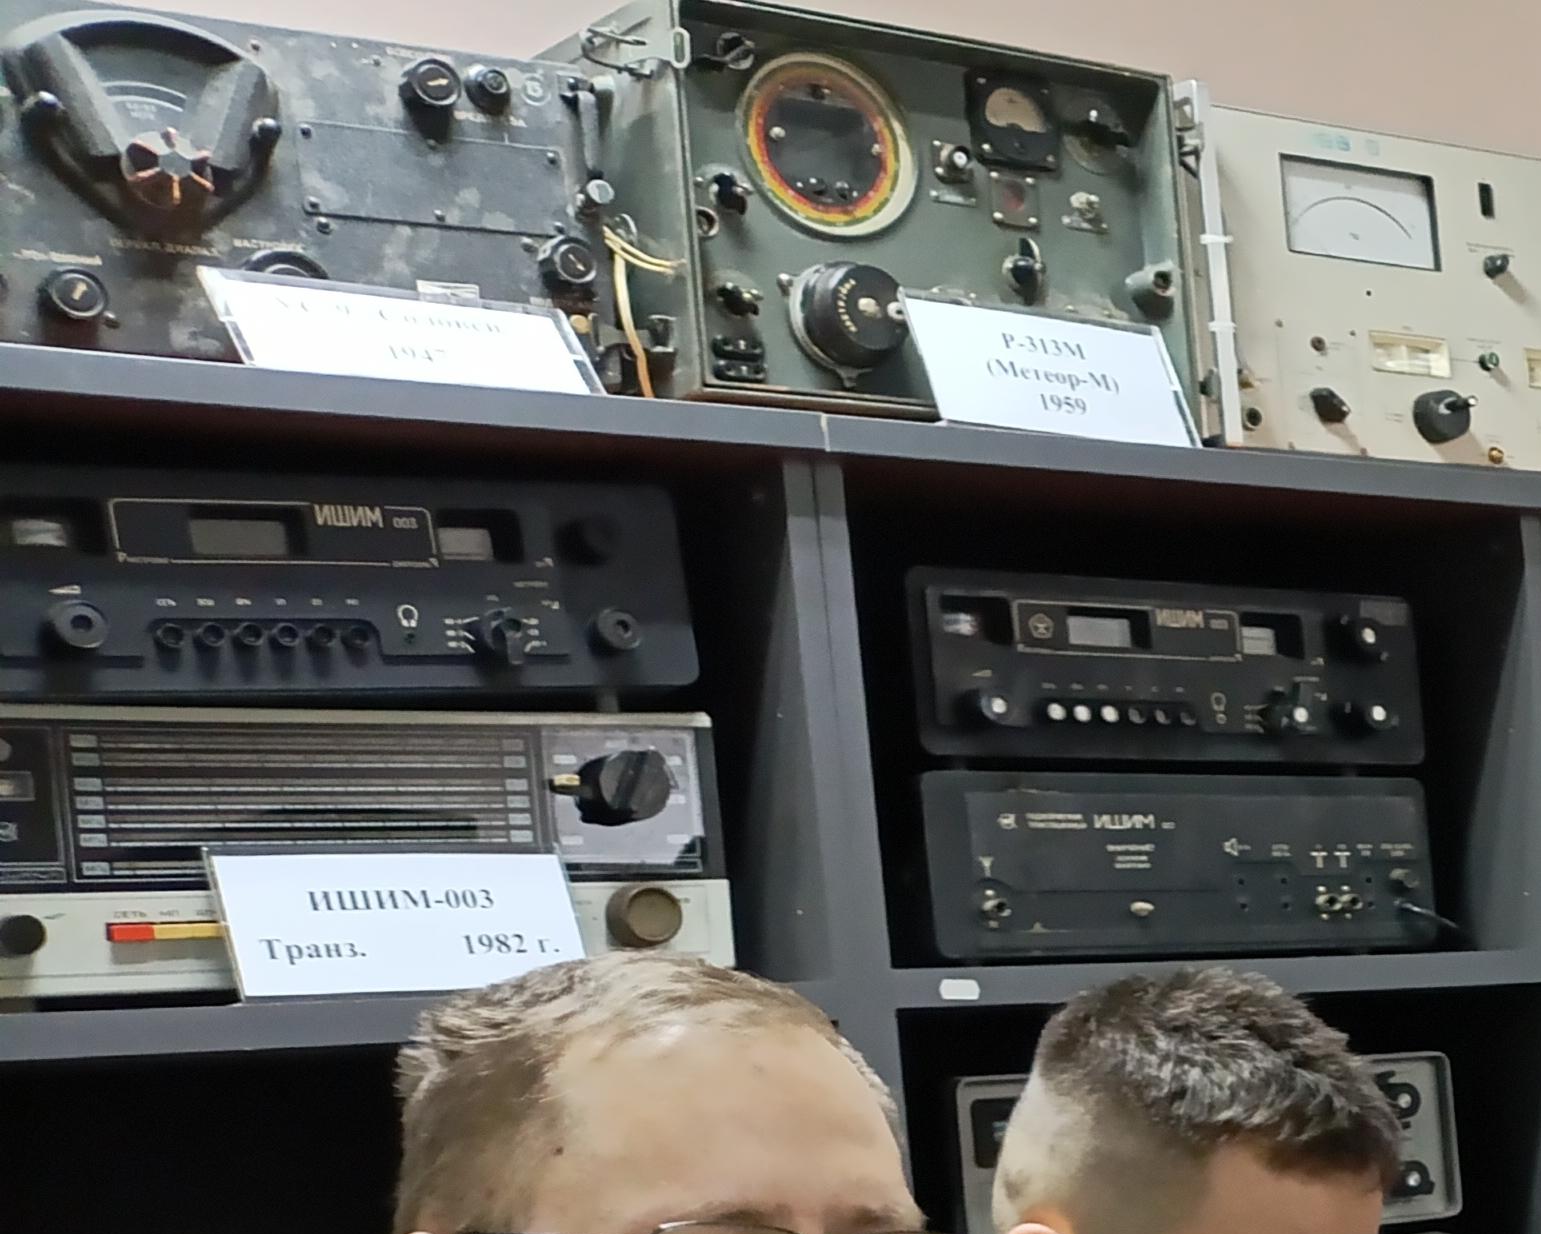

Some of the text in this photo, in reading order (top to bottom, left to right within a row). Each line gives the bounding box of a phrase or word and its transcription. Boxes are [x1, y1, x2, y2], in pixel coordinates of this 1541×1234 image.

[1001, 332, 1087, 360] Р-313М
[986, 358, 1120, 395] (Метеор-М)
[1040, 393, 1087, 415] 1959
[313, 504, 384, 528] ИШИМ
[1093, 813, 1156, 830] ИШИМ
[308, 888, 496, 912] ИШИМ-003
[258, 933, 562, 966] Транз. 1982 г.
